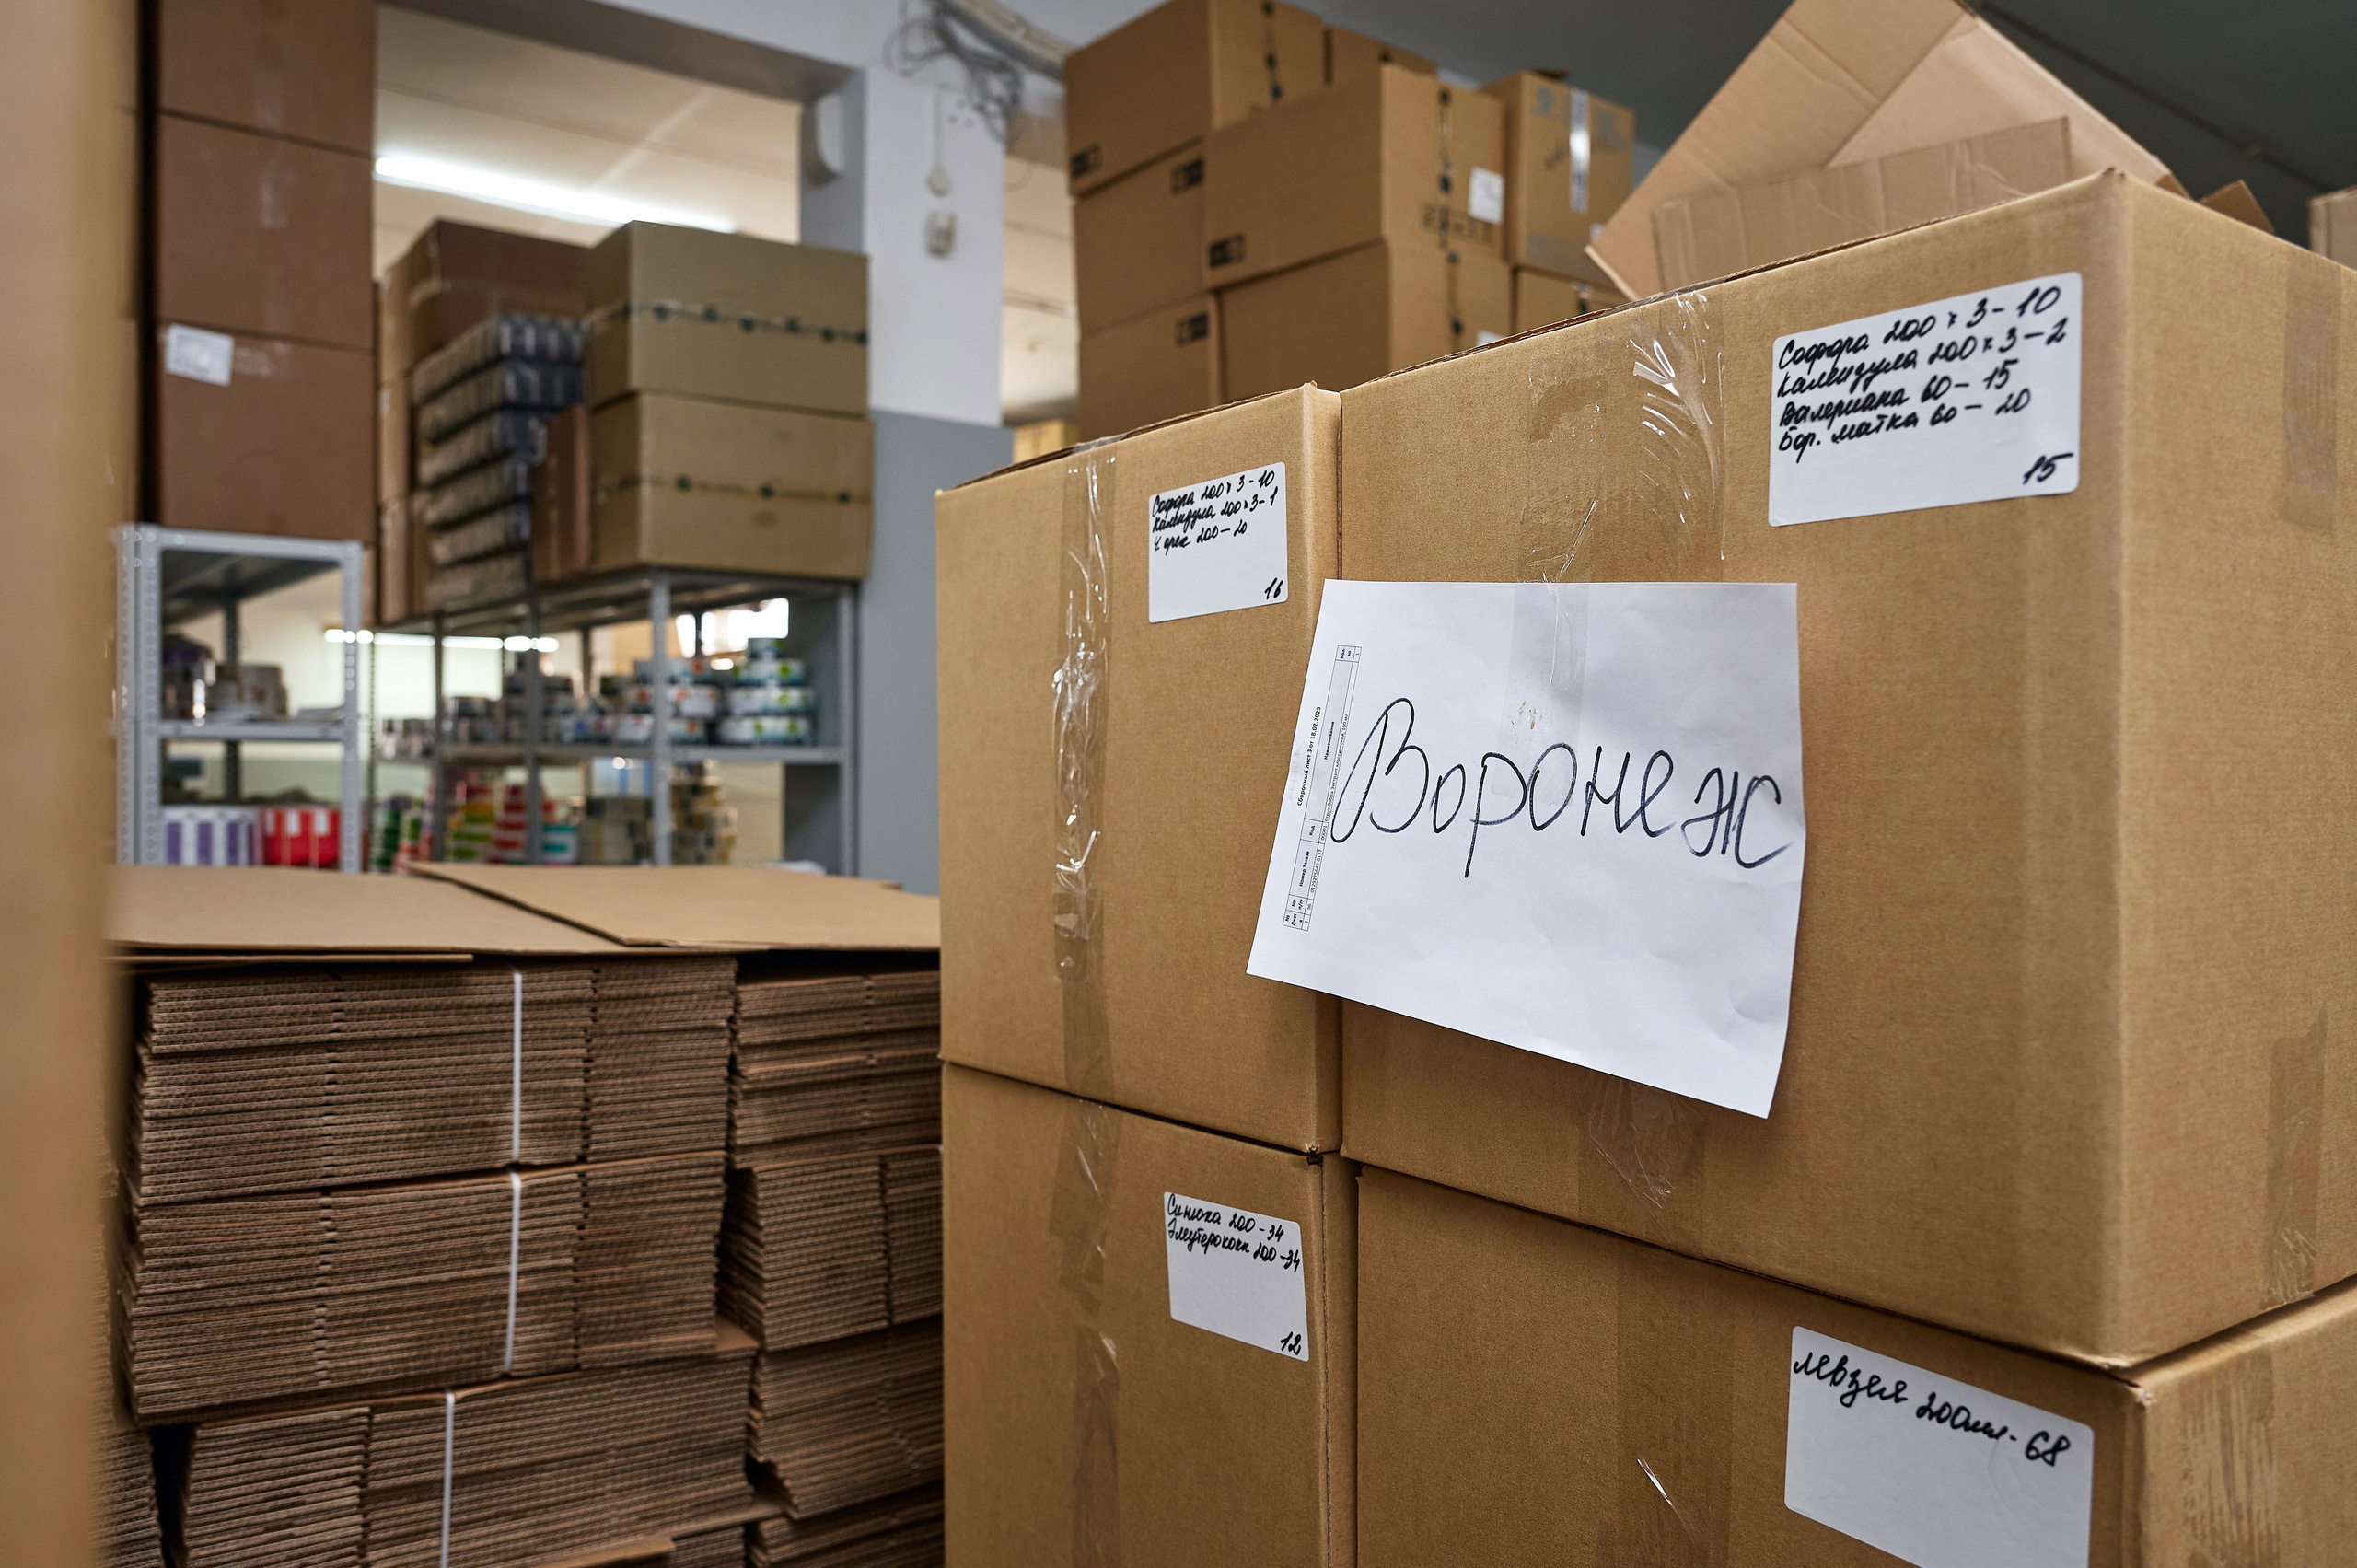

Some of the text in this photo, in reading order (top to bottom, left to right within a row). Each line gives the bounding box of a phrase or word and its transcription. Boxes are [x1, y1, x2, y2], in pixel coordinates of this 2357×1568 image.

[1779, 387, 1910, 430] Валериана
[1831, 411, 1918, 444] матка
[2023, 451, 2074, 485] 15
[1264, 577, 1283, 599] 16
[1297, 770, 1309, 807] Сборочный
[1310, 706, 1321, 740] 18.02.2025
[1324, 721, 1335, 761] Наименование
[1330, 697, 1794, 877] Воронеж
[1280, 1331, 1302, 1355] 12
